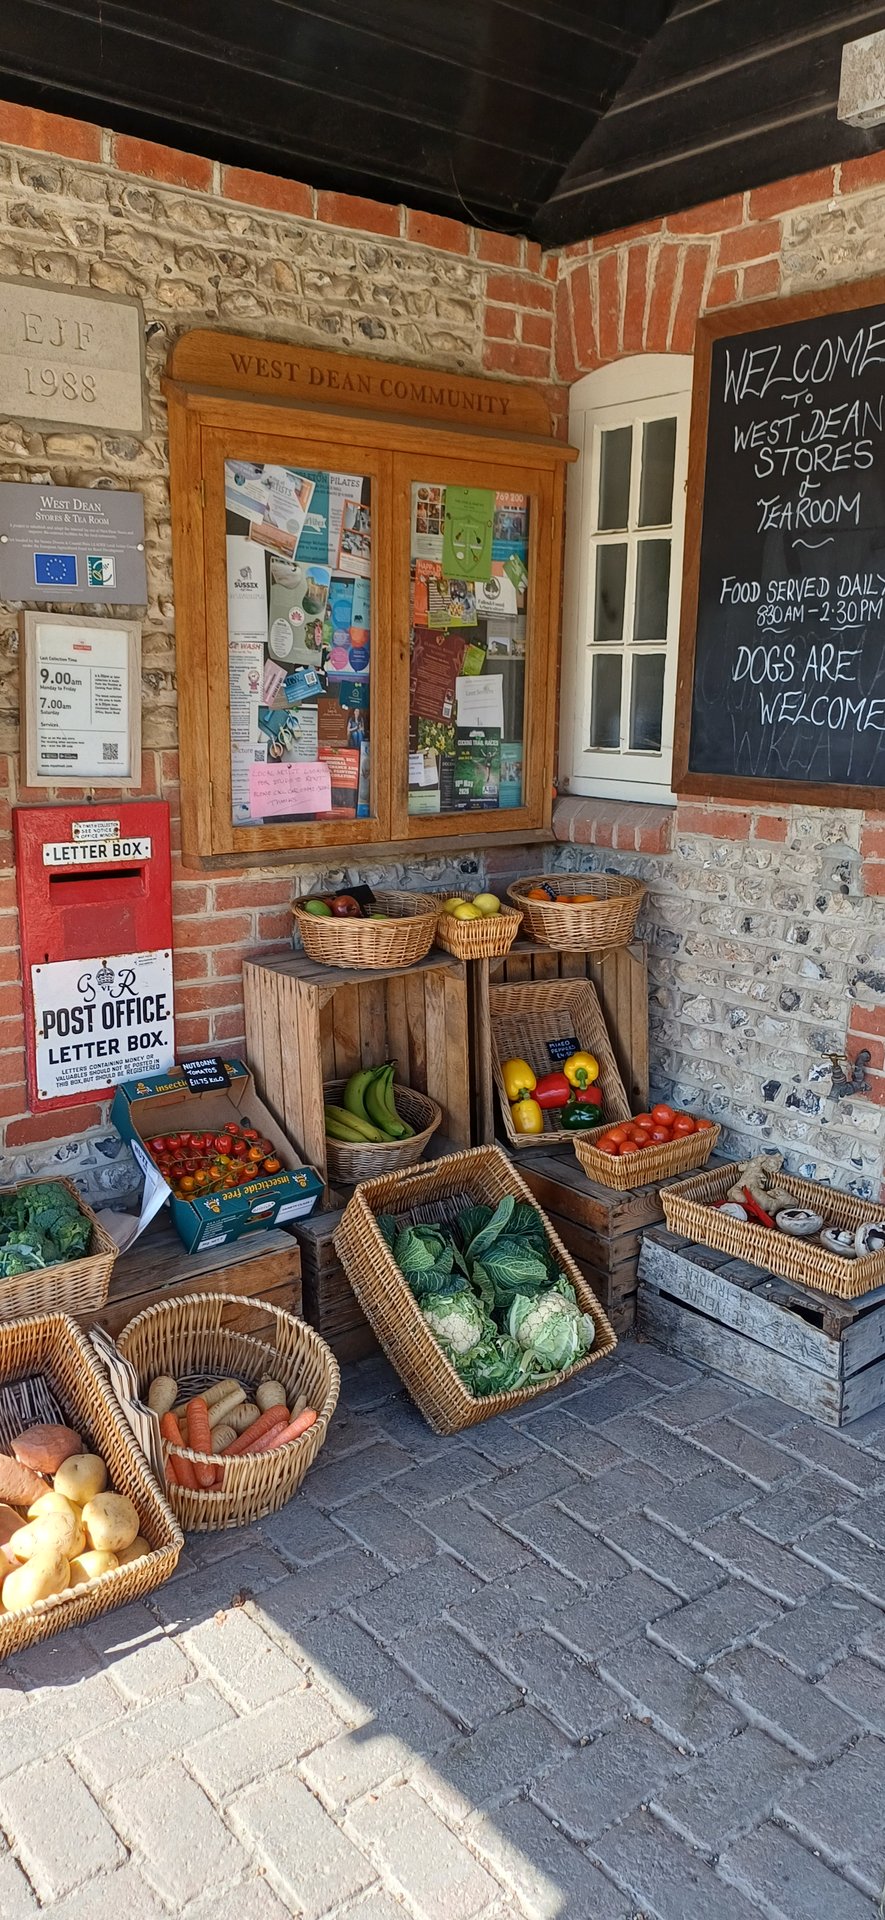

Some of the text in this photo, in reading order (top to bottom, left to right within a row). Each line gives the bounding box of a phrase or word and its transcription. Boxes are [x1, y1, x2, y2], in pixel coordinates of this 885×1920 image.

[21, 312, 94, 351] EJF
[724, 321, 885, 405] WELCOME
[24, 368, 97, 403] 1988
[230, 352, 511, 416] WEST DEAN COMMUNITY
[734, 395, 884, 453] WEST DEAN
[754, 440, 874, 479] STORES
[330, 476, 360, 488] PILATES
[35, 511, 110, 525] STORES & TEA ROOM
[40, 496, 102, 512] WEST DEAN
[719, 573, 885, 604] FOOD SERVED DAILY
[732, 643, 863, 684] DOGS ARE
[759, 691, 885, 732] WELCOME
[53, 842, 142, 861] LETTER BOX
[77, 973, 96, 1002] G
[110, 968, 139, 998] R
[42, 1004, 96, 1039] POST
[49, 1030, 168, 1065] LETTER BOX.
[56, 1072, 88, 1082] VALUABLES
[89, 1068, 110, 1076] SHOULD
[132, 1060, 152, 1068] POSTED
[62, 1066, 87, 1075] LETTERS
[90, 1059, 123, 1070] CONTAINING
[125, 1055, 145, 1063] MONEY
[96, 1072, 115, 1081] SHOULD
[126, 1064, 160, 1075] REGISTERED
[222, 1175, 290, 1200] insecticide free
